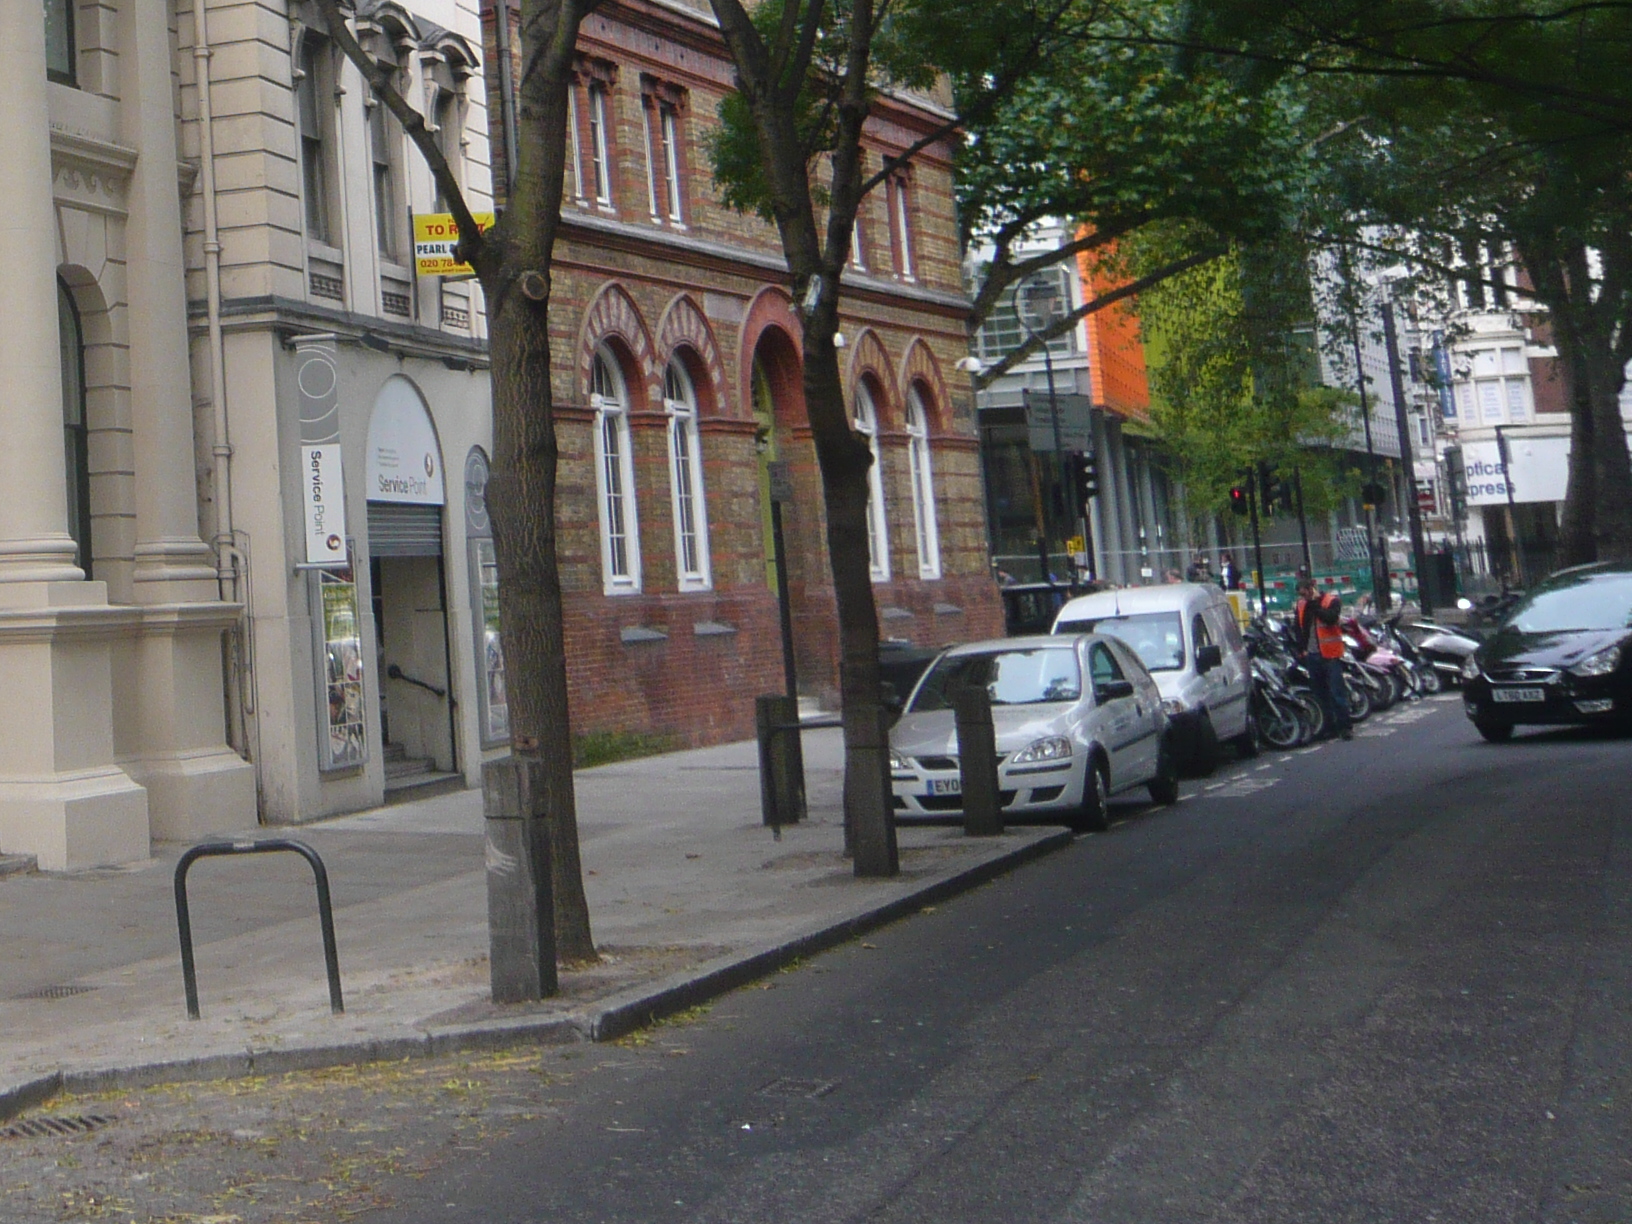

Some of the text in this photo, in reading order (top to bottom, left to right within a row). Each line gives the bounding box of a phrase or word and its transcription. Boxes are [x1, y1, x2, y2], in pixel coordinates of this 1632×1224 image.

[425, 223, 486, 236] TO RT
[416, 244, 447, 255] PEARL
[420, 258, 438, 268] 020
[1465, 460, 1506, 479] ptica
[378, 473, 427, 496] Service Point
[1466, 481, 1517, 497] press
[310, 450, 325, 535] Service Point
[934, 779, 961, 793] EY0
